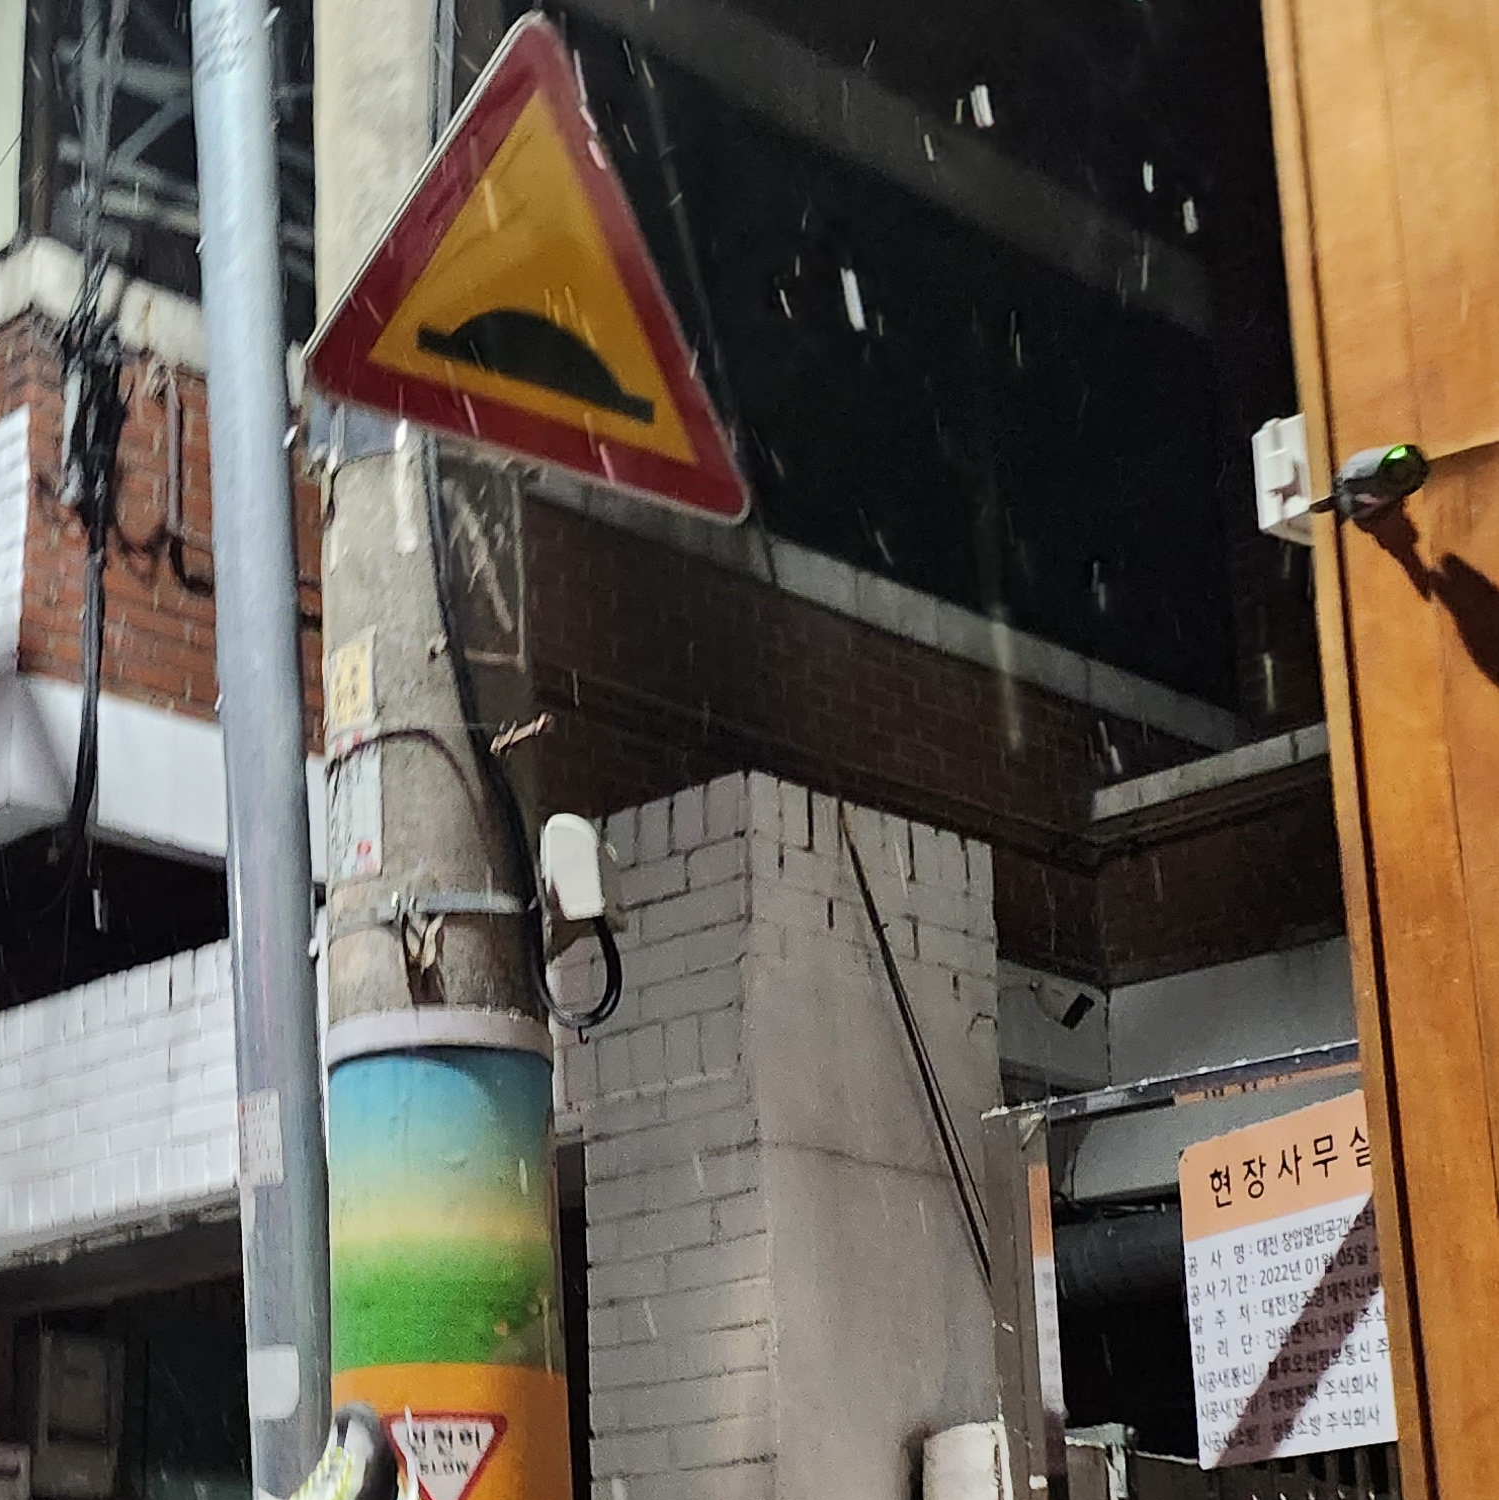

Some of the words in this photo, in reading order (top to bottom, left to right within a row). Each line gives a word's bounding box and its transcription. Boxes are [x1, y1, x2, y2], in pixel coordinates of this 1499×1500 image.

[1257, 1234, 1278, 1258] 대전
[1259, 1259, 1301, 1289] 2022년
[1304, 1251, 1334, 1278] 01월
[1323, 1371, 1378, 1400] 주식회사
[1325, 1404, 1380, 1433] 주식회사
